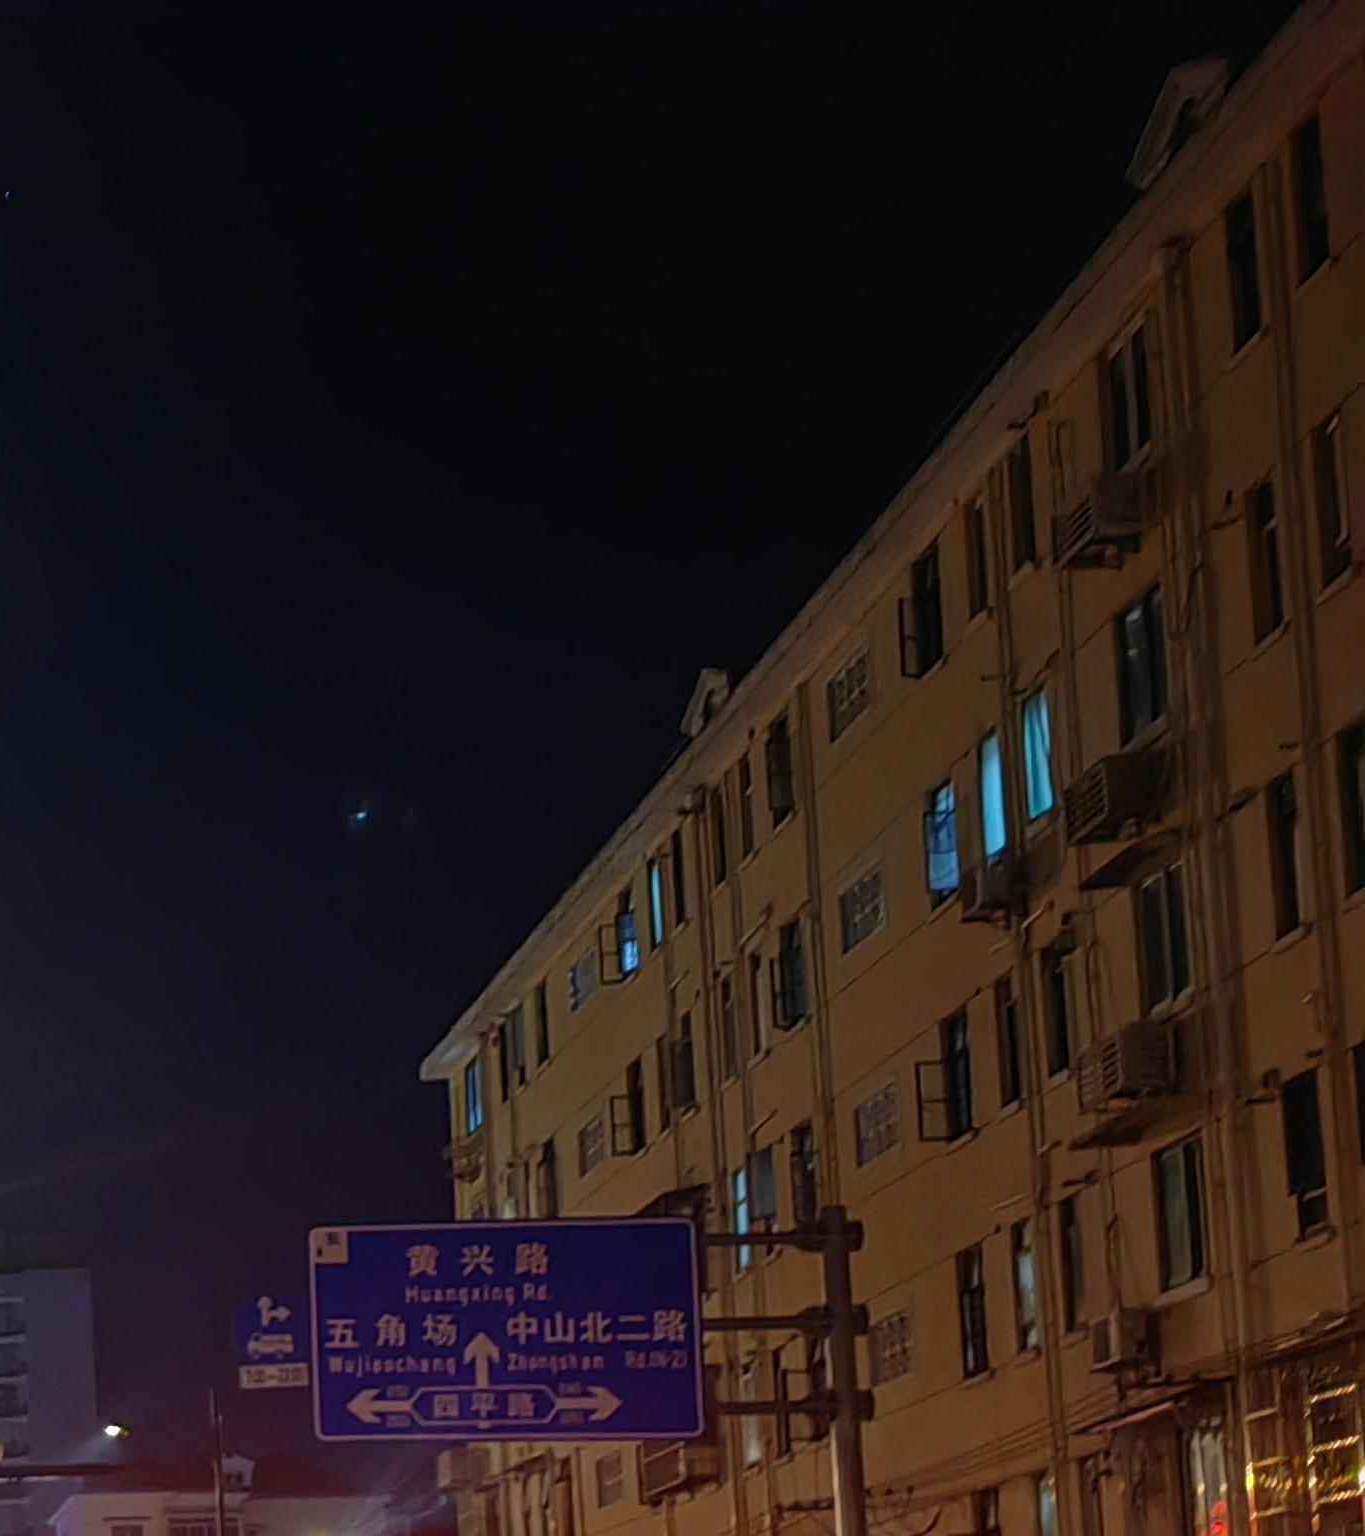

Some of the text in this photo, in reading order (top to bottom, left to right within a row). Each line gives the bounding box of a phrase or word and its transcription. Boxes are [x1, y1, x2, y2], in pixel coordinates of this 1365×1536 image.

[405, 1242, 549, 1277] 黄兴路
[324, 1312, 458, 1348] 五角场
[506, 1309, 688, 1345] 中山北二路
